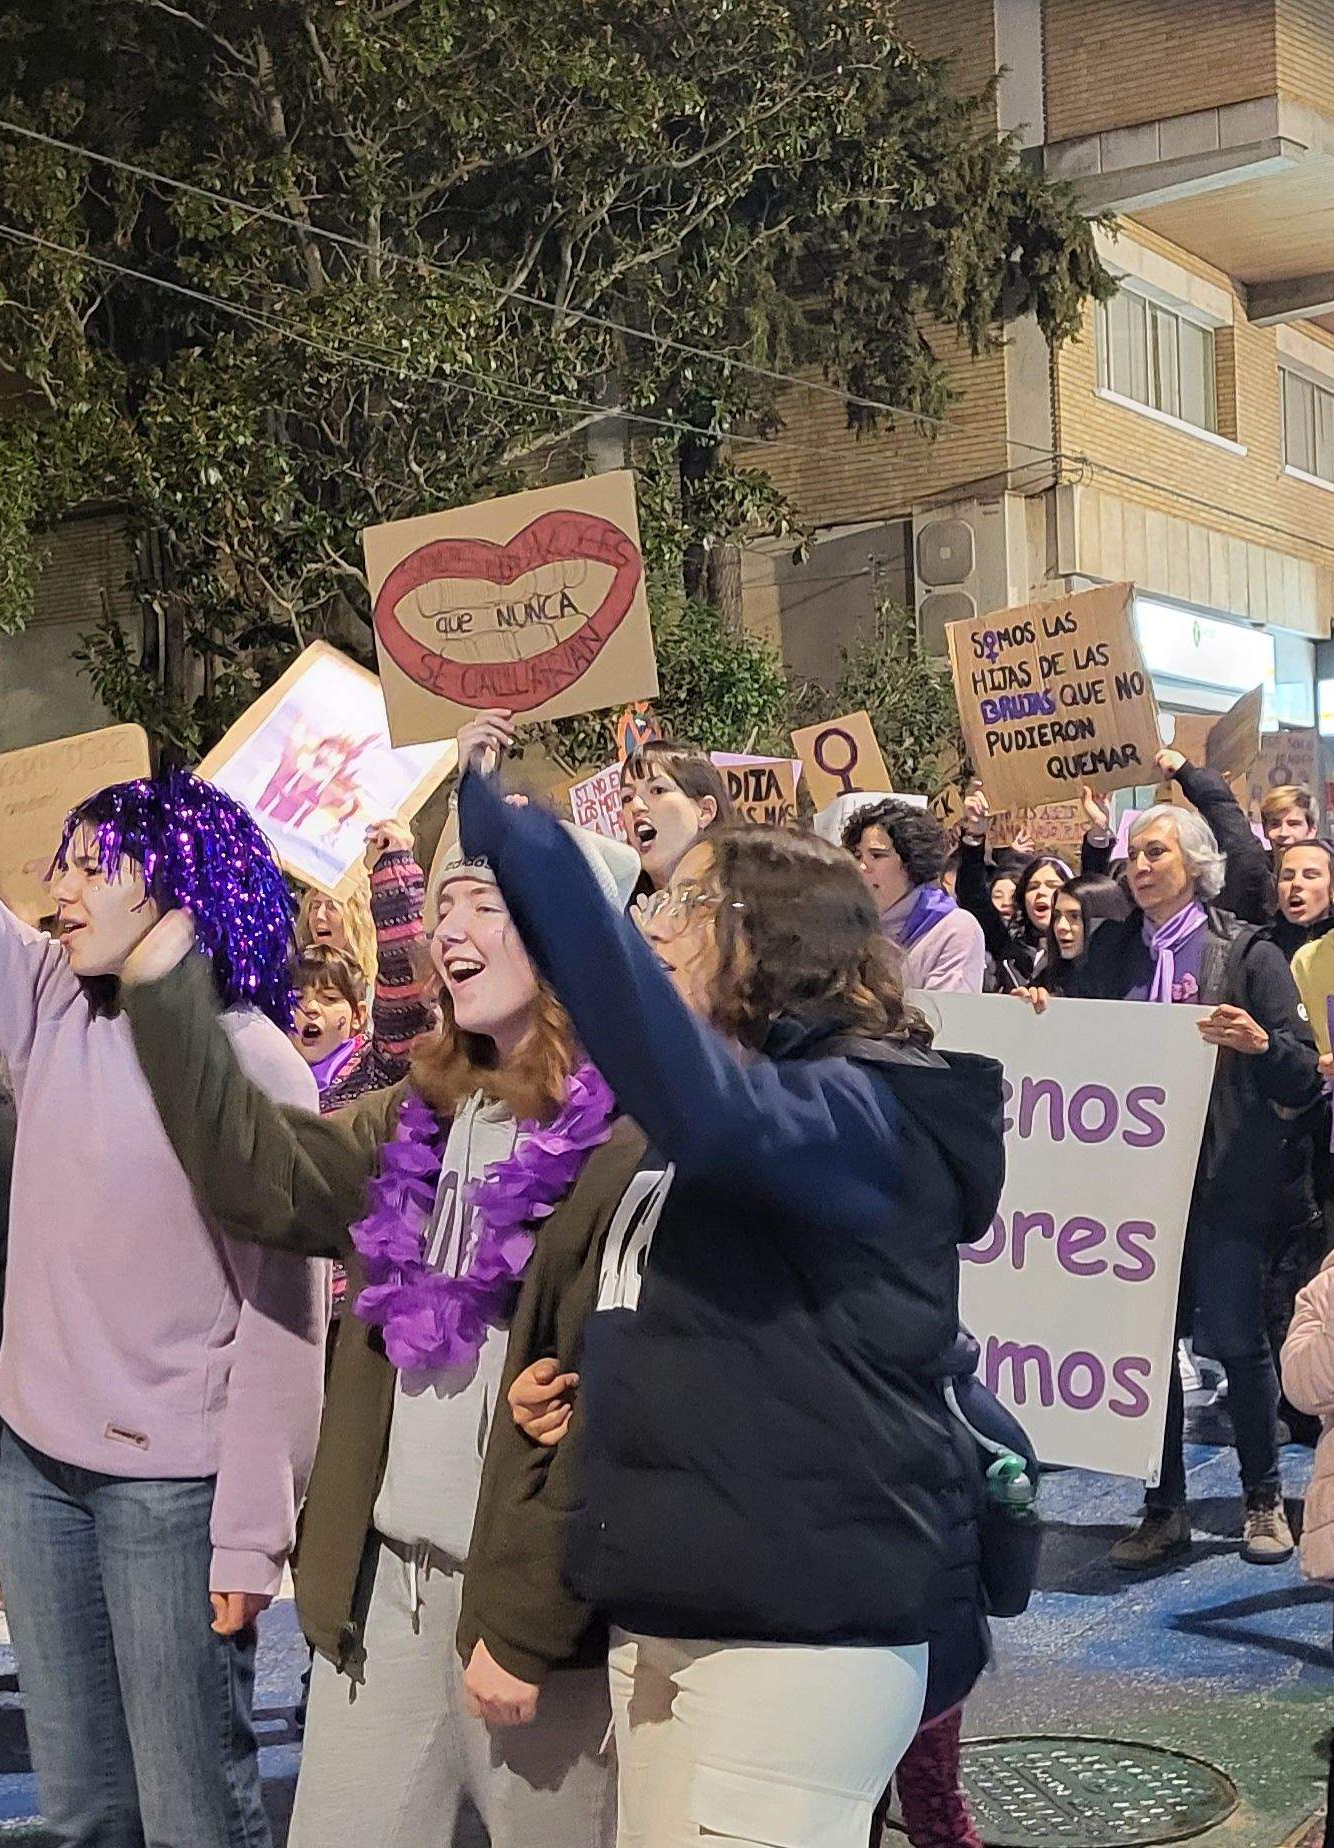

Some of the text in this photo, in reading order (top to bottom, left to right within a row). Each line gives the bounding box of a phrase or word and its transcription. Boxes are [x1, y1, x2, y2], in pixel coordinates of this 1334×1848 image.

[496, 592, 580, 628] NUNCA
[1042, 611, 1078, 638] LAS
[971, 643, 1110, 695] HIJAS DE LAS
[980, 670, 1144, 725] BRUJAS QUE NO
[985, 716, 1096, 757] PUDIERON
[1046, 743, 1142, 780] QUEMAR
